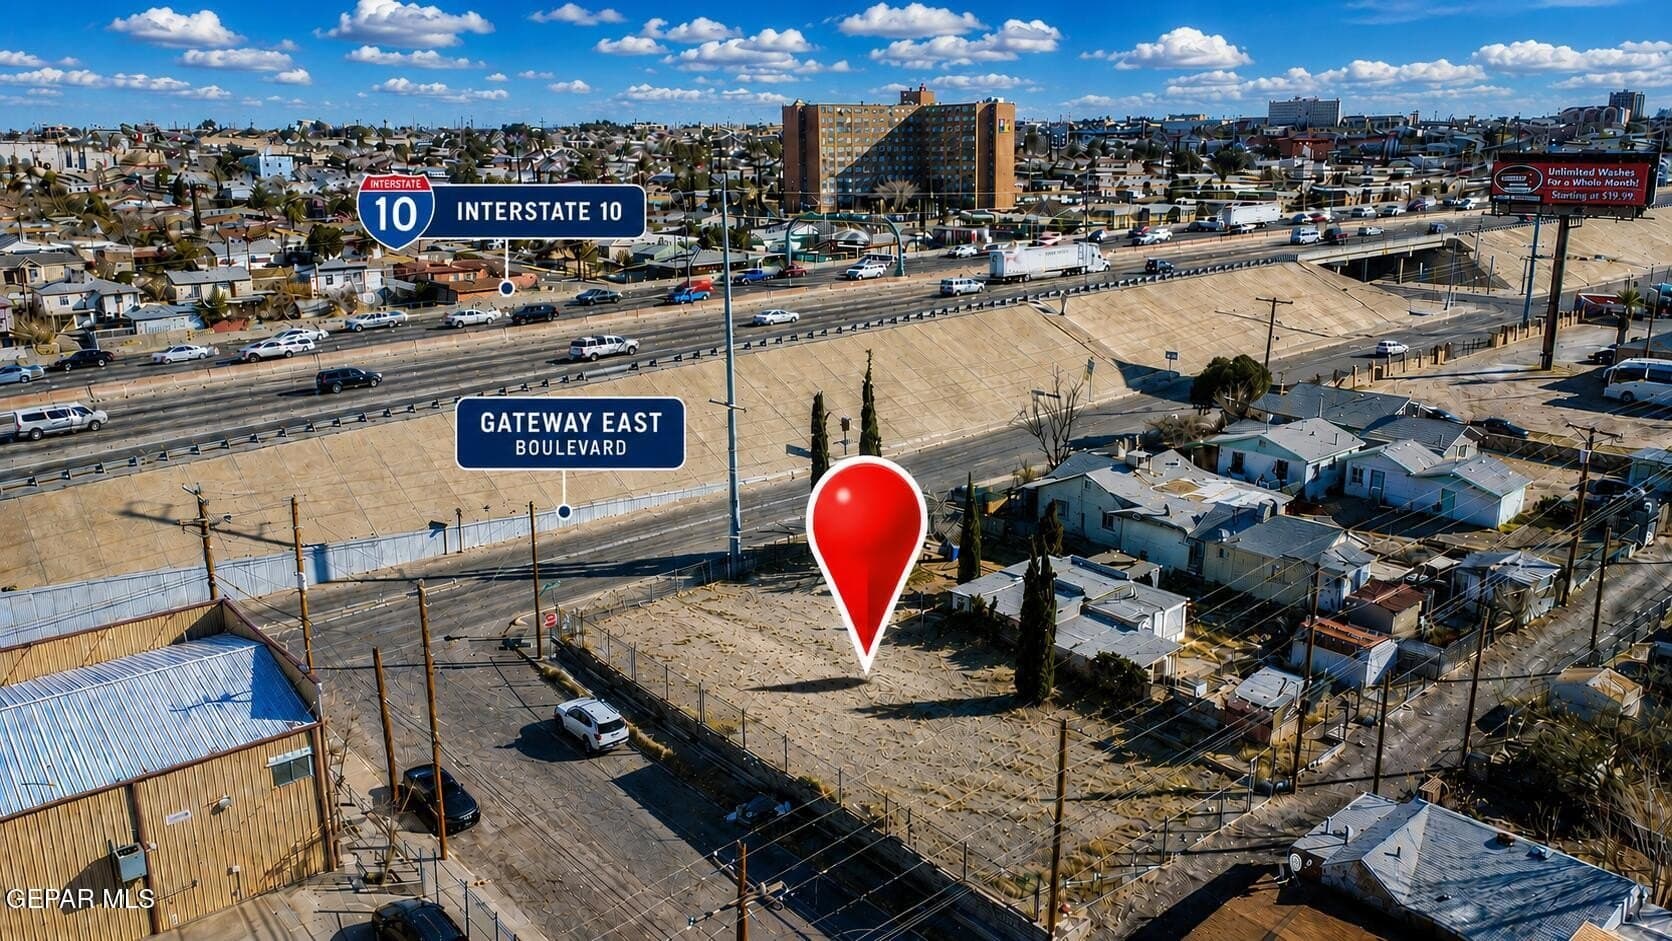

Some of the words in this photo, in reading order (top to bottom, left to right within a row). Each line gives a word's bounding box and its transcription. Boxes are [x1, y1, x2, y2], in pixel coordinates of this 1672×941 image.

[1548, 167, 1595, 176] Unlimited
[1598, 168, 1635, 176] Washes
[1547, 178, 1561, 186] For
[1572, 178, 1602, 186] Whole
[1605, 179, 1639, 187] Month!
[1552, 190, 1587, 201] Starting
